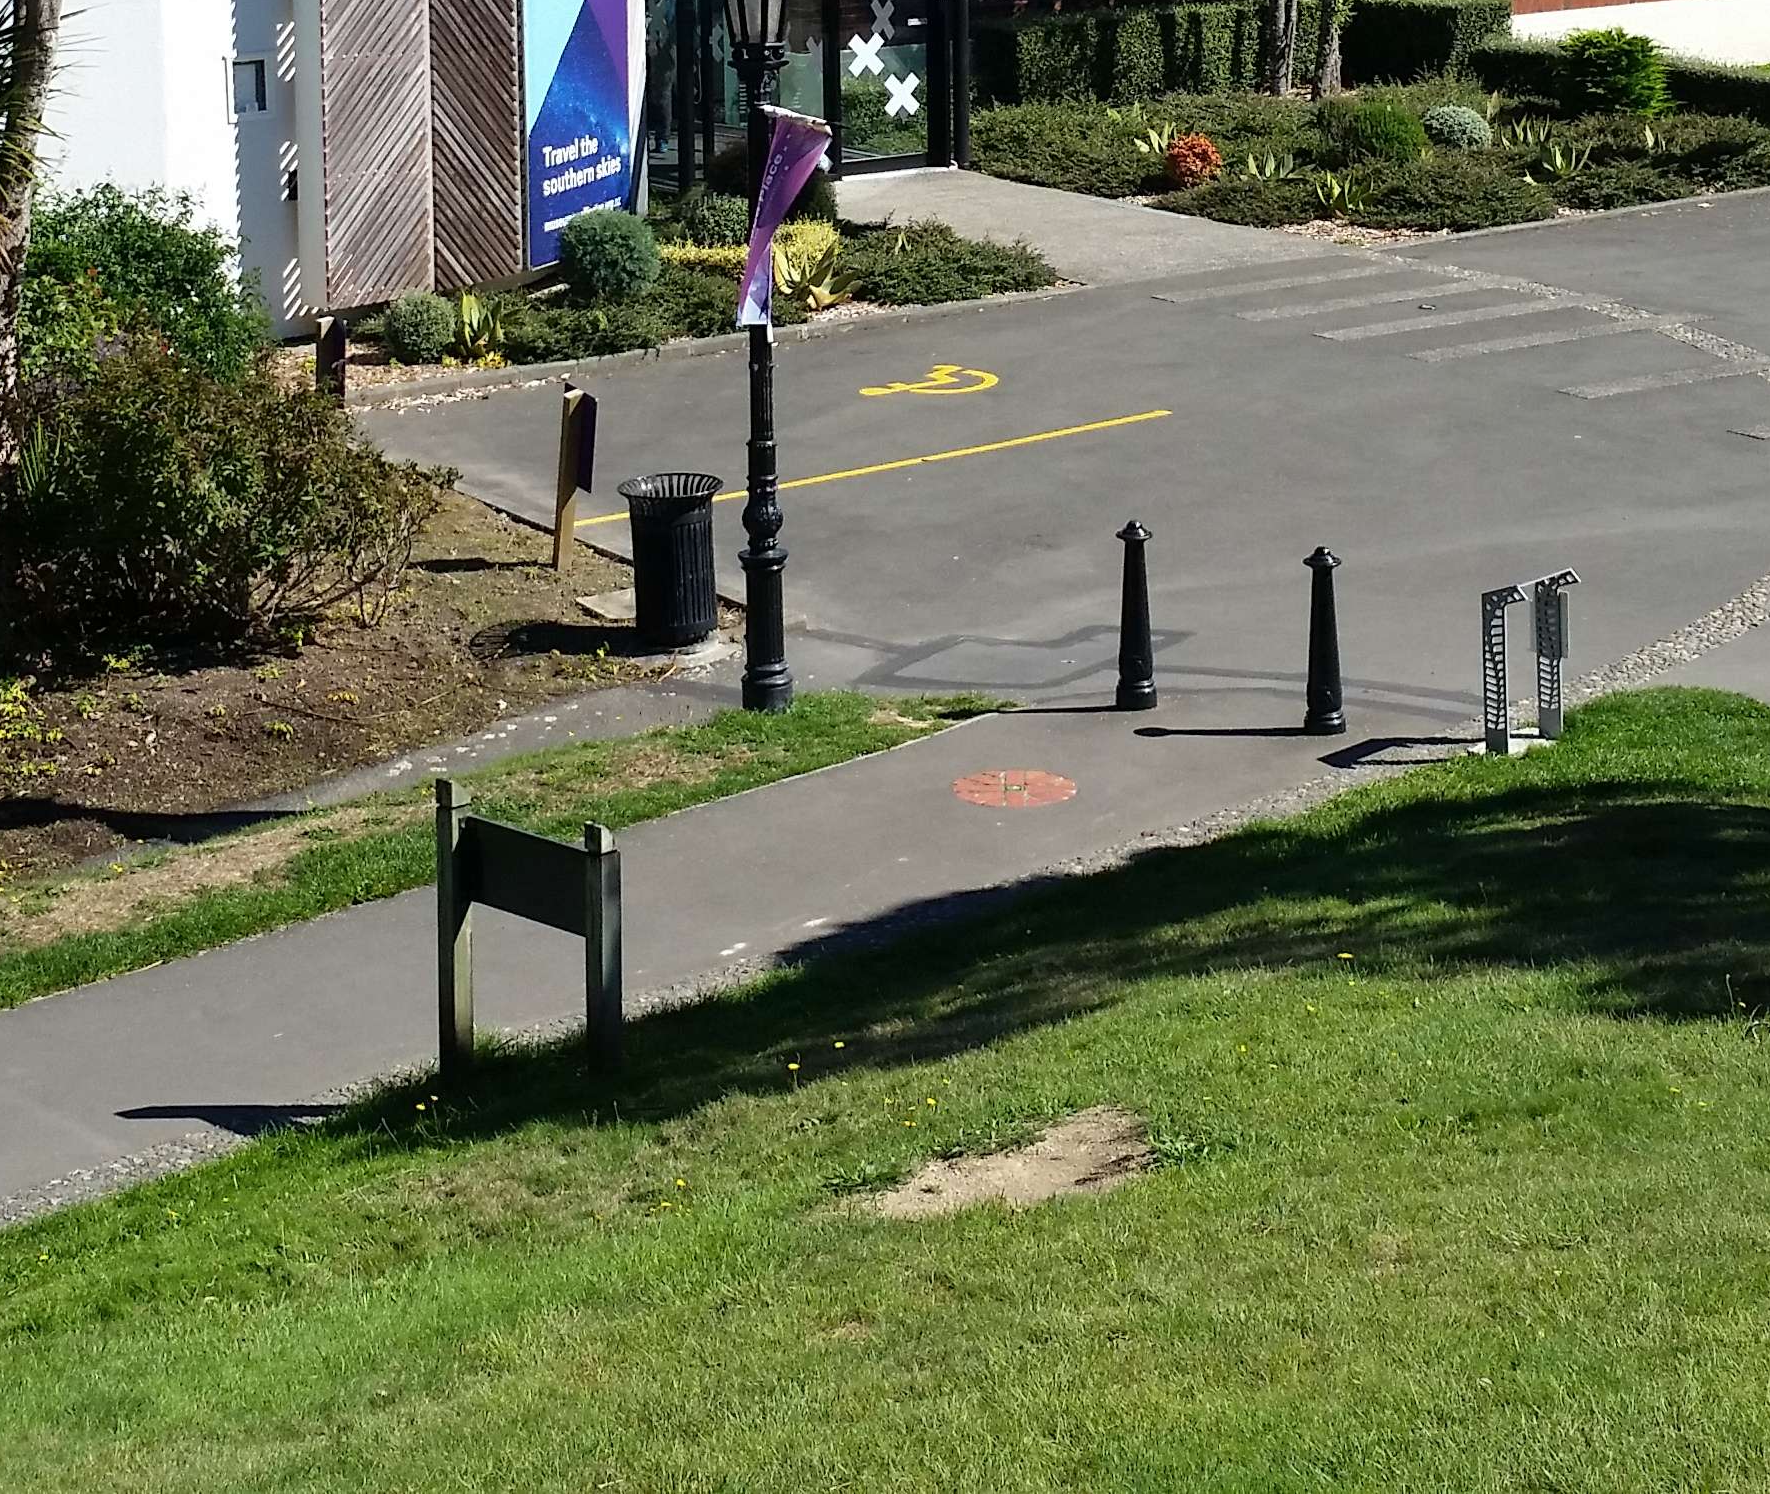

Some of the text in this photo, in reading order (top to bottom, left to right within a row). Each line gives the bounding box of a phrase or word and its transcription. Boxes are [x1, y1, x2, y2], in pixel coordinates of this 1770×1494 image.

[542, 134, 599, 168] Travel the
[542, 154, 622, 197] southern skies
